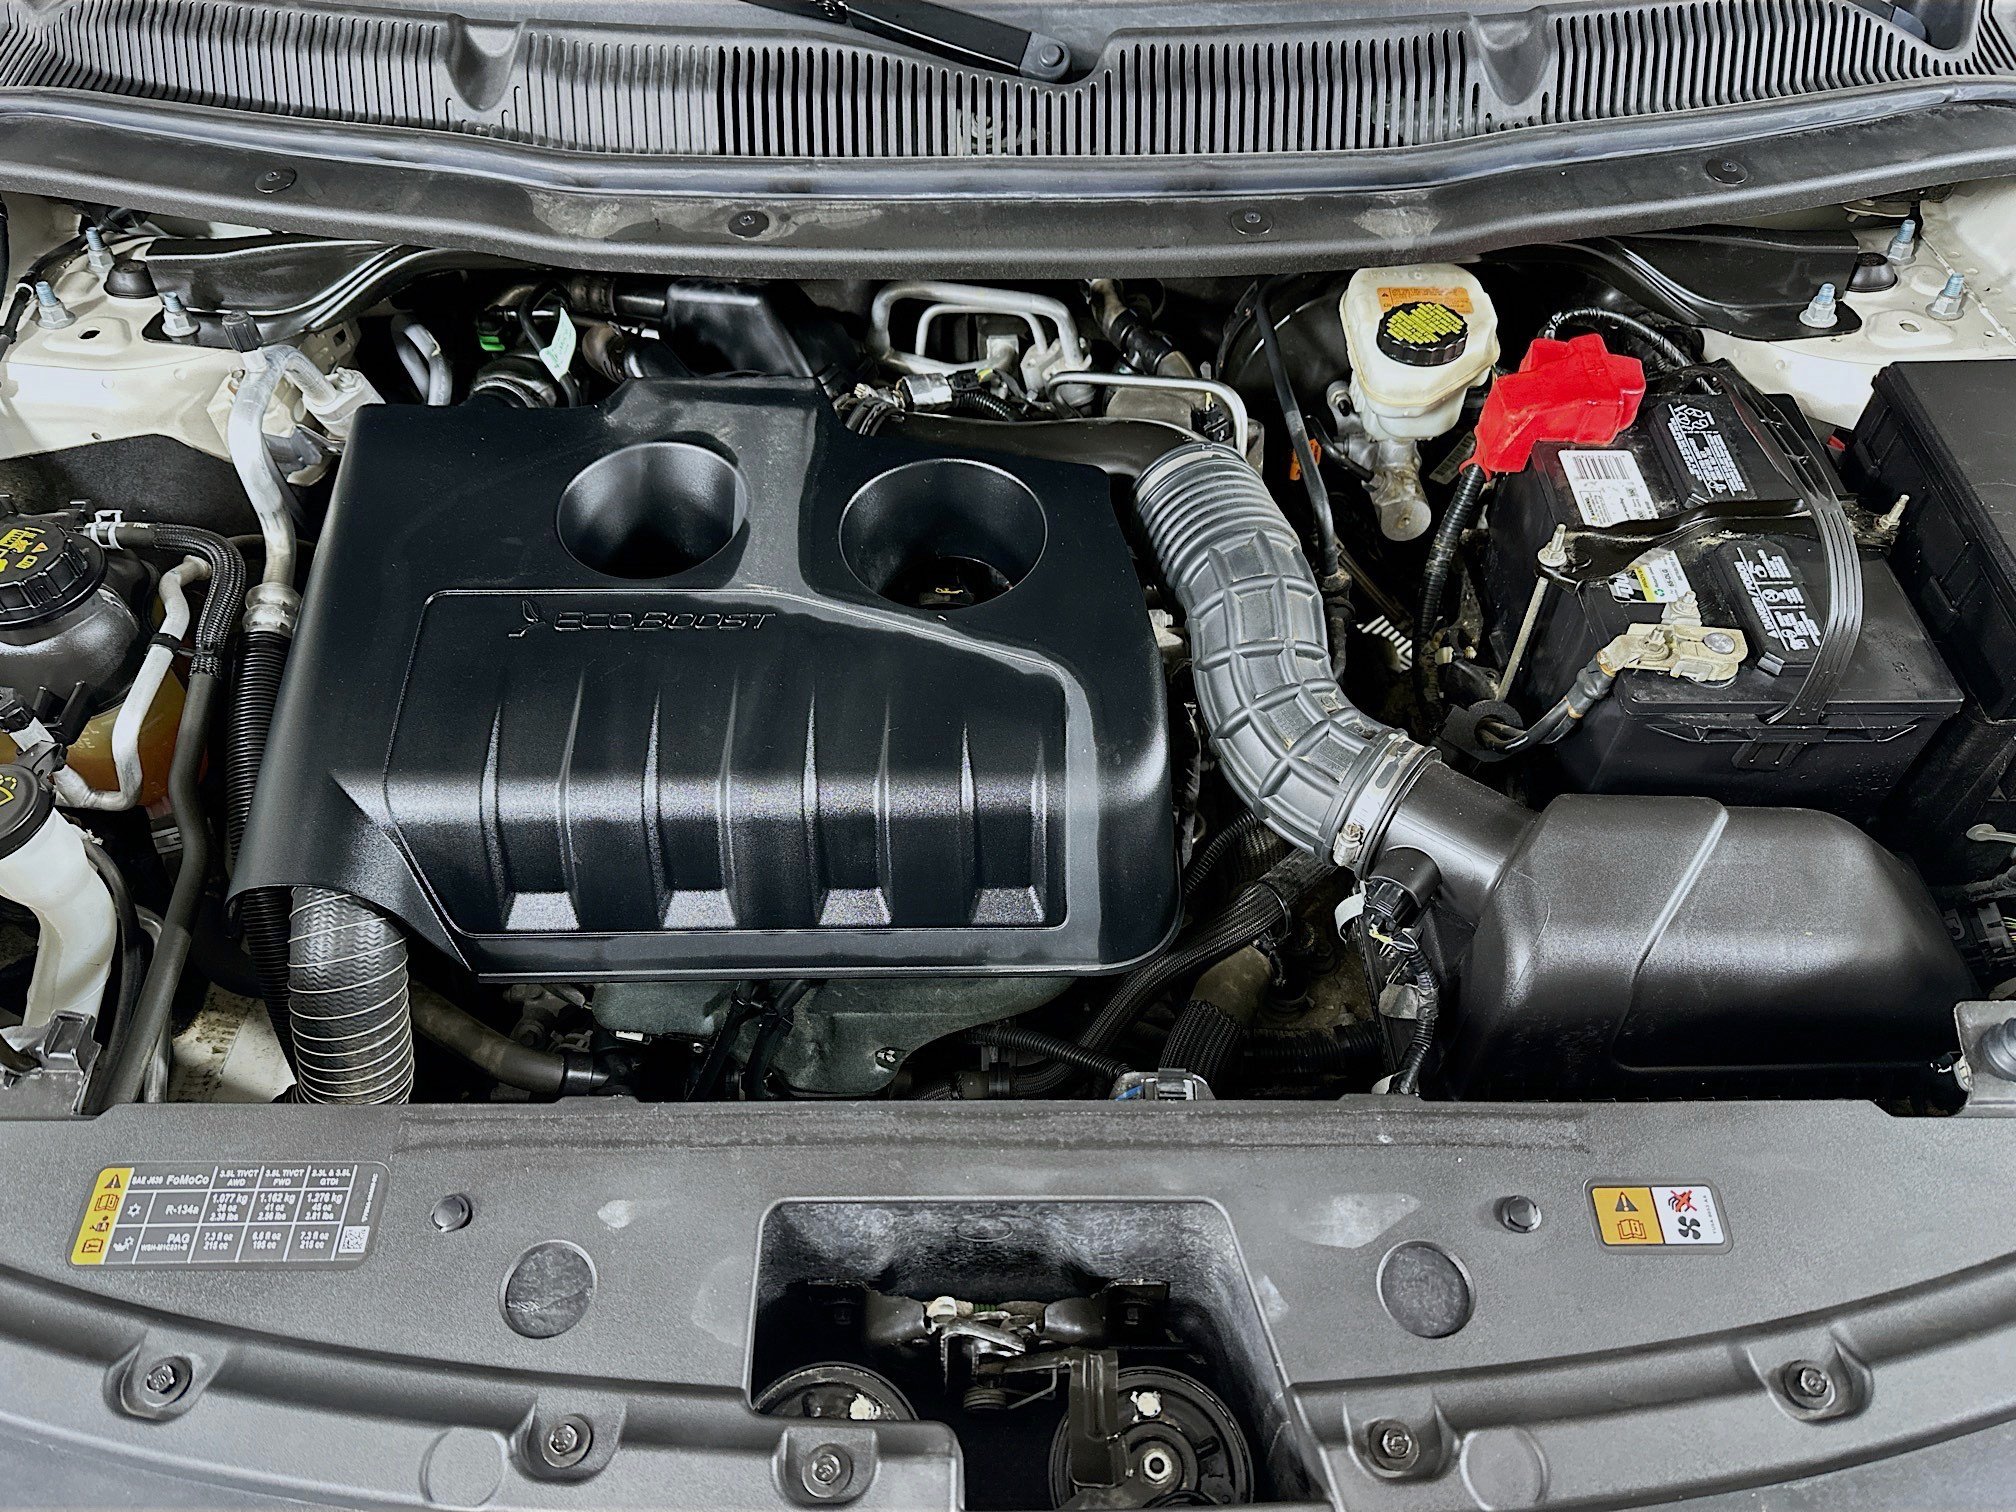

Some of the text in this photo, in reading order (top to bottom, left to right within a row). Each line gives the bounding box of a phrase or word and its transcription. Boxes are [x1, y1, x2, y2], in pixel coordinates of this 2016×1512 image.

[1751, 596, 1775, 631] DANGER
[166, 1174, 210, 1185] FoMoCo
[226, 1178, 246, 1187] AWD
[273, 1178, 292, 1186] FWD
[212, 1193, 249, 1205] 1.077 kg
[260, 1193, 296, 1205] 1.162 kg
[331, 1193, 343, 1205] kg
[165, 1204, 200, 1215] R-134a
[264, 1203, 274, 1211] 41
[227, 1212, 239, 1221] lbs
[274, 1212, 287, 1221] lbs
[322, 1212, 334, 1221] lbs
[166, 1233, 191, 1244] PAG
[223, 1233, 234, 1241] oz
[218, 1242, 229, 1250] cc
[315, 1241, 325, 1249] cc
